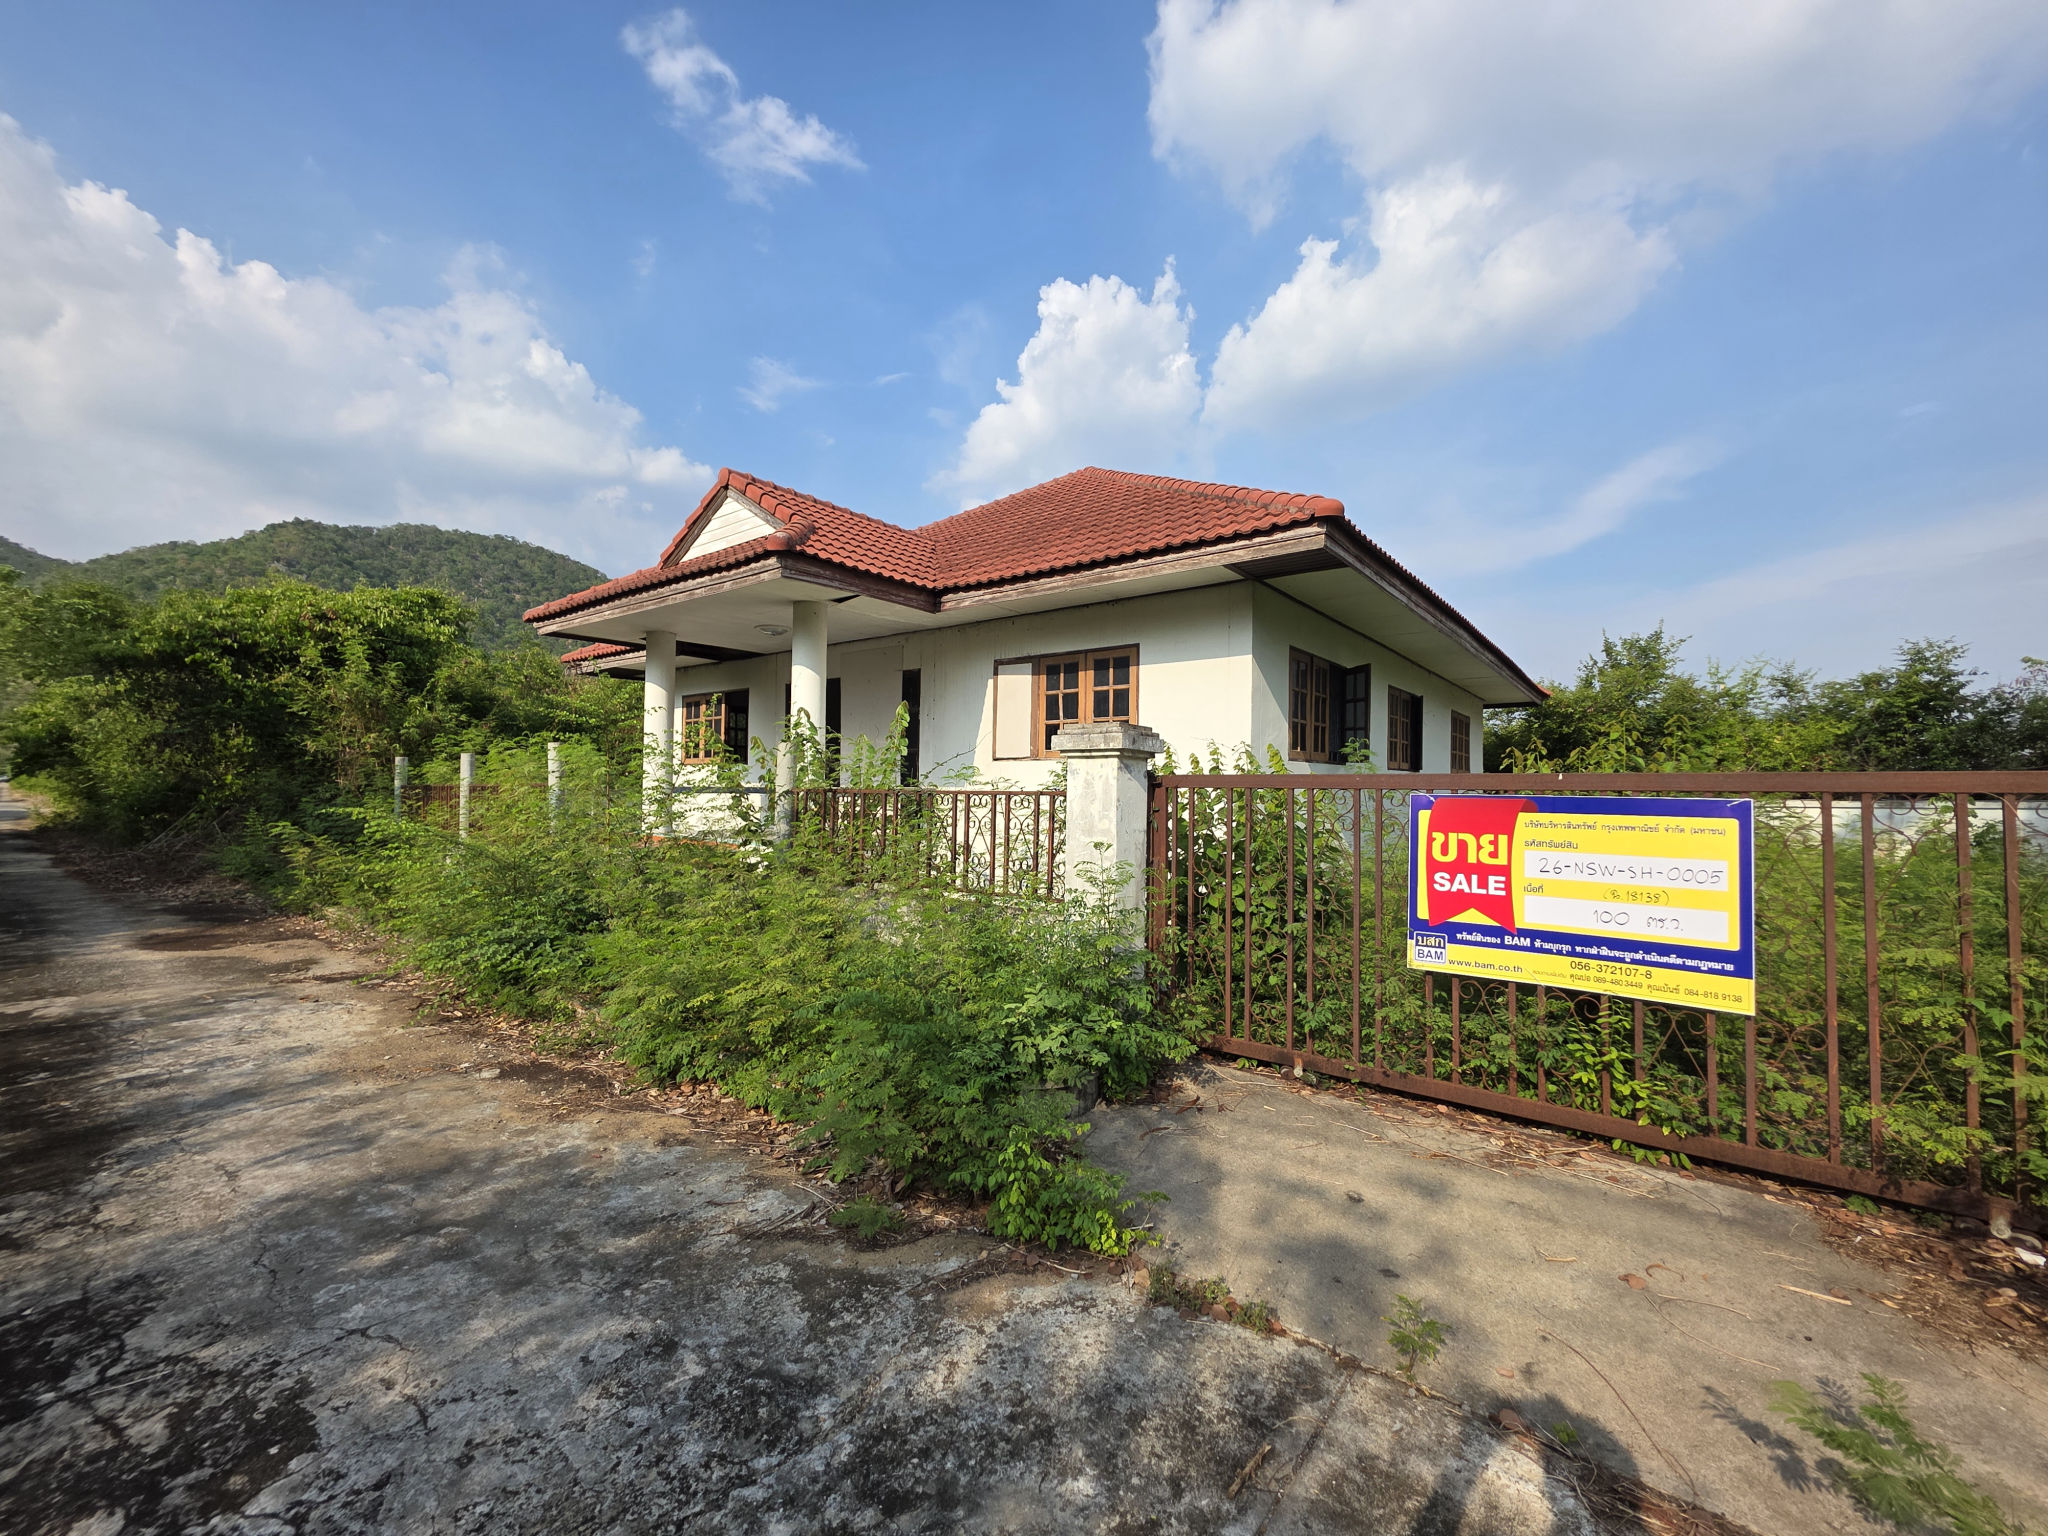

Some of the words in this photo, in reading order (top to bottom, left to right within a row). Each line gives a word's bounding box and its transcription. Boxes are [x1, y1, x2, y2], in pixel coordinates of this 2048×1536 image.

[1524, 819, 1597, 830] บริษัทบริหารสินทรัพย์
[1601, 822, 1660, 835] กรุงเทพพาณิชย์
[1664, 824, 1686, 834] จำกัด
[1690, 826, 1726, 836] (มหาชน)
[1431, 831, 1509, 866] ขาย
[1524, 838, 1579, 850] รหัสทรัพย์สิน
[1538, 857, 1725, 884] 26-NSW-SH-0005
[1432, 871, 1507, 896] SALE
[1523, 884, 1545, 895] เนื้อที่
[1593, 909, 1630, 926] 100
[1417, 935, 1444, 948] บสก
[1456, 931, 1501, 944] ทรัพย์สินของ
[1504, 934, 1531, 947] BAM
[1534, 938, 1572, 954] ห้ามบุกรุก
[1417, 948, 1444, 961] BAM
[1448, 958, 1523, 974] www.bam.co.th
[1570, 960, 1653, 980] 056-372107-8
